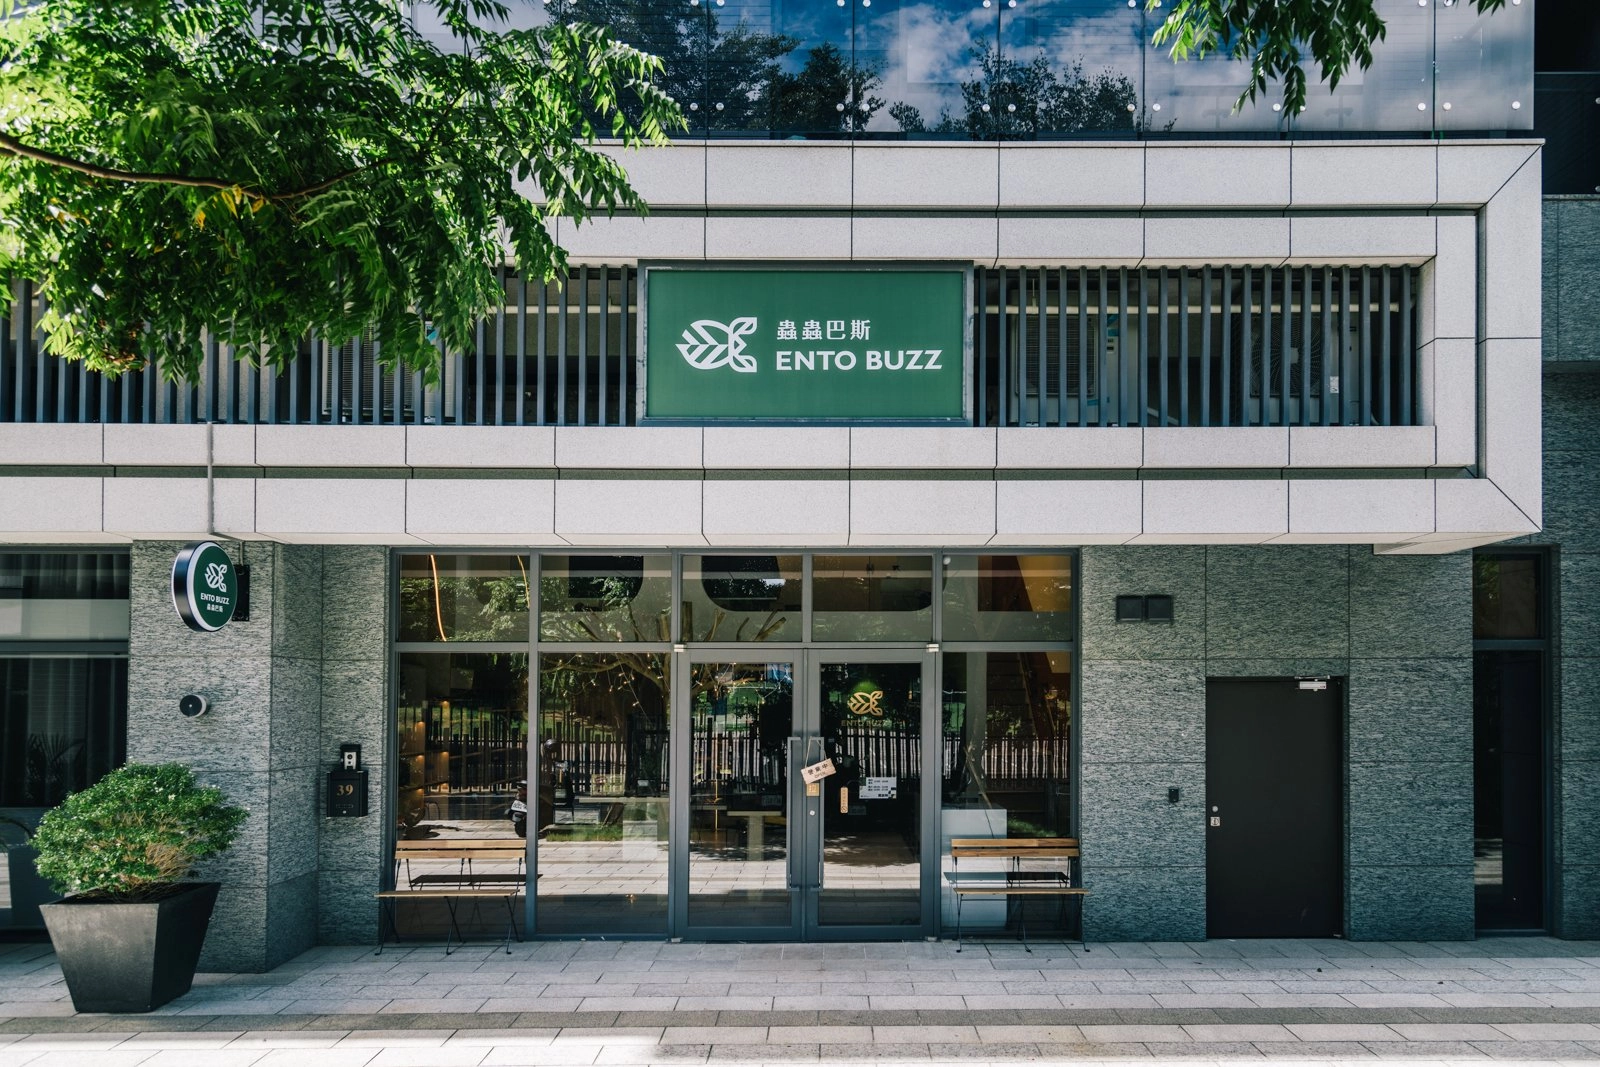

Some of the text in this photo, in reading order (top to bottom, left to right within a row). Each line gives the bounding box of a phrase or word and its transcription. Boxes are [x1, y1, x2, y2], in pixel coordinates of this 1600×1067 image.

[776, 319, 871, 341] 蟲蟲巴斯
[776, 350, 943, 371] ENTO BUZZ
[201, 593, 229, 604] ENTO BUZZ
[336, 784, 354, 796] 39
